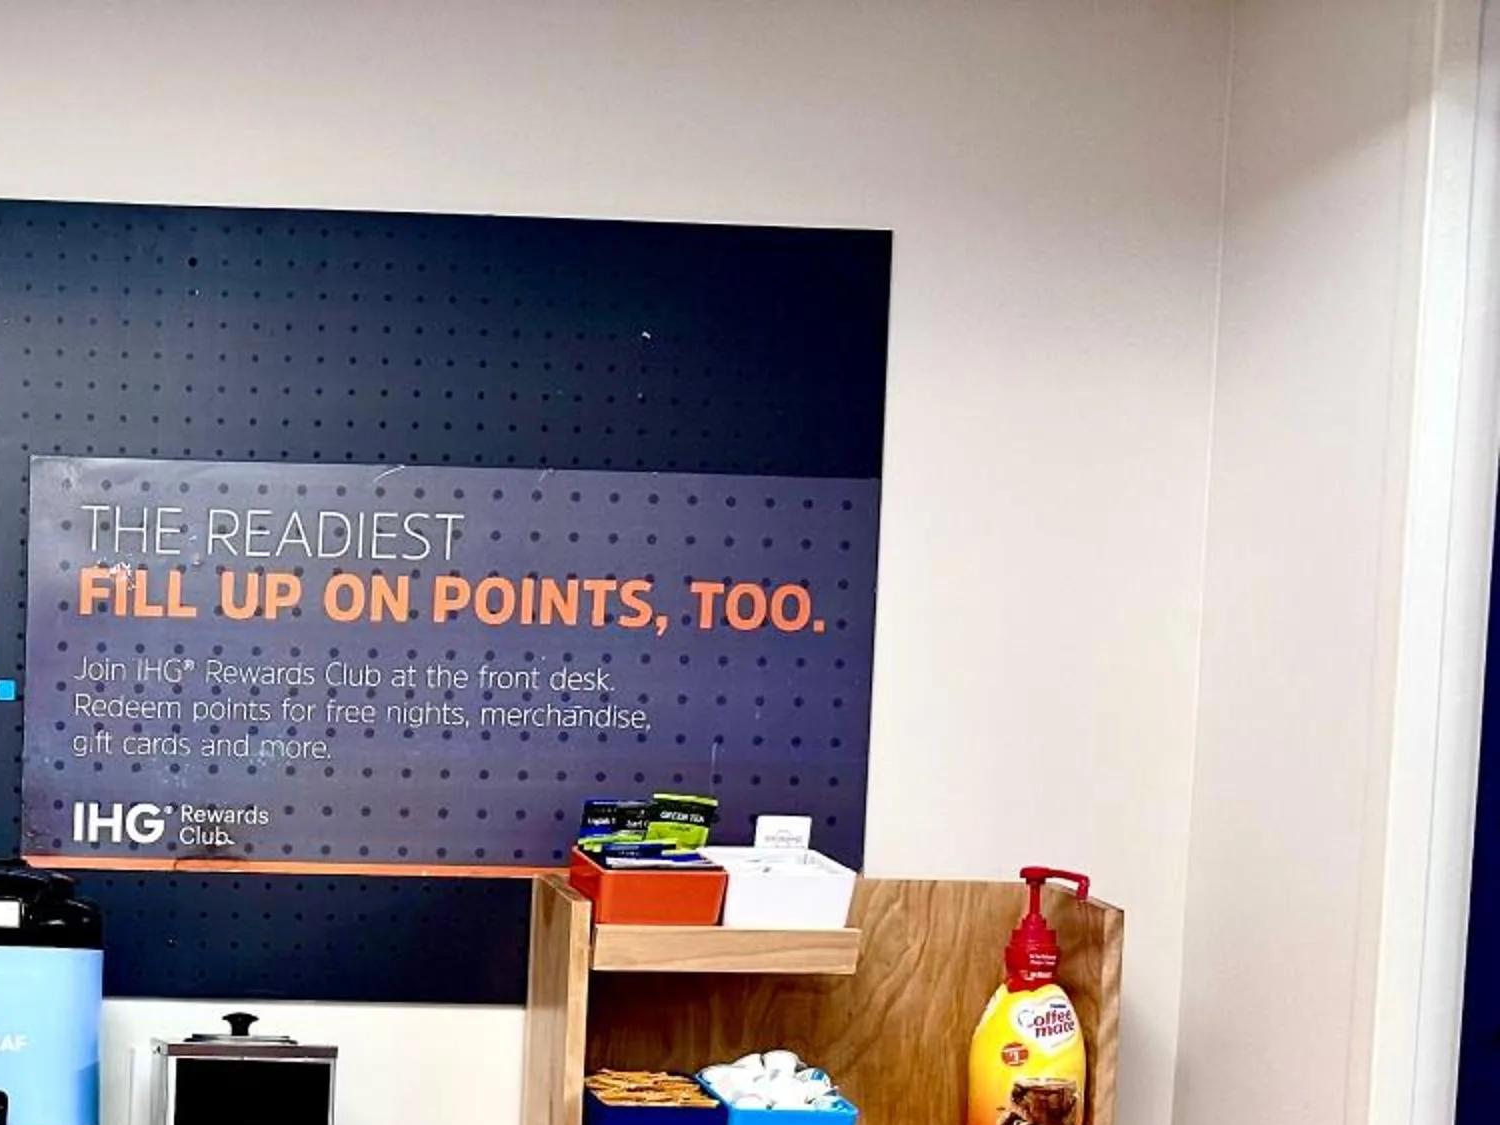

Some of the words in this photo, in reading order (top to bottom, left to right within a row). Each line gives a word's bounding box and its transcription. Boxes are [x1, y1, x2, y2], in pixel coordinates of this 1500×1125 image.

[81, 505, 182, 555] THE
[207, 509, 465, 561] READIEST
[79, 566, 197, 620] FILL
[220, 571, 301, 621] UP
[323, 573, 409, 624] ON
[433, 575, 669, 637] POINTS,
[690, 580, 826, 633] TOO.
[73, 657, 126, 682] Join
[205, 659, 315, 686] Rewards
[325, 661, 381, 687] Club
[391, 668, 416, 688] at
[427, 664, 469, 689] the
[478, 665, 541, 690] front
[550, 666, 615, 692] desk.
[74, 693, 182, 720] Redeem
[192, 697, 271, 722] points
[282, 697, 316, 723] for
[325, 698, 376, 724] free
[386, 700, 470, 728] nights,
[480, 703, 651, 731] merchandise,
[72, 730, 112, 756] gift
[123, 733, 191, 756] cards
[201, 734, 249, 757] and
[260, 741, 332, 759] more.
[180, 804, 269, 825] Rewards
